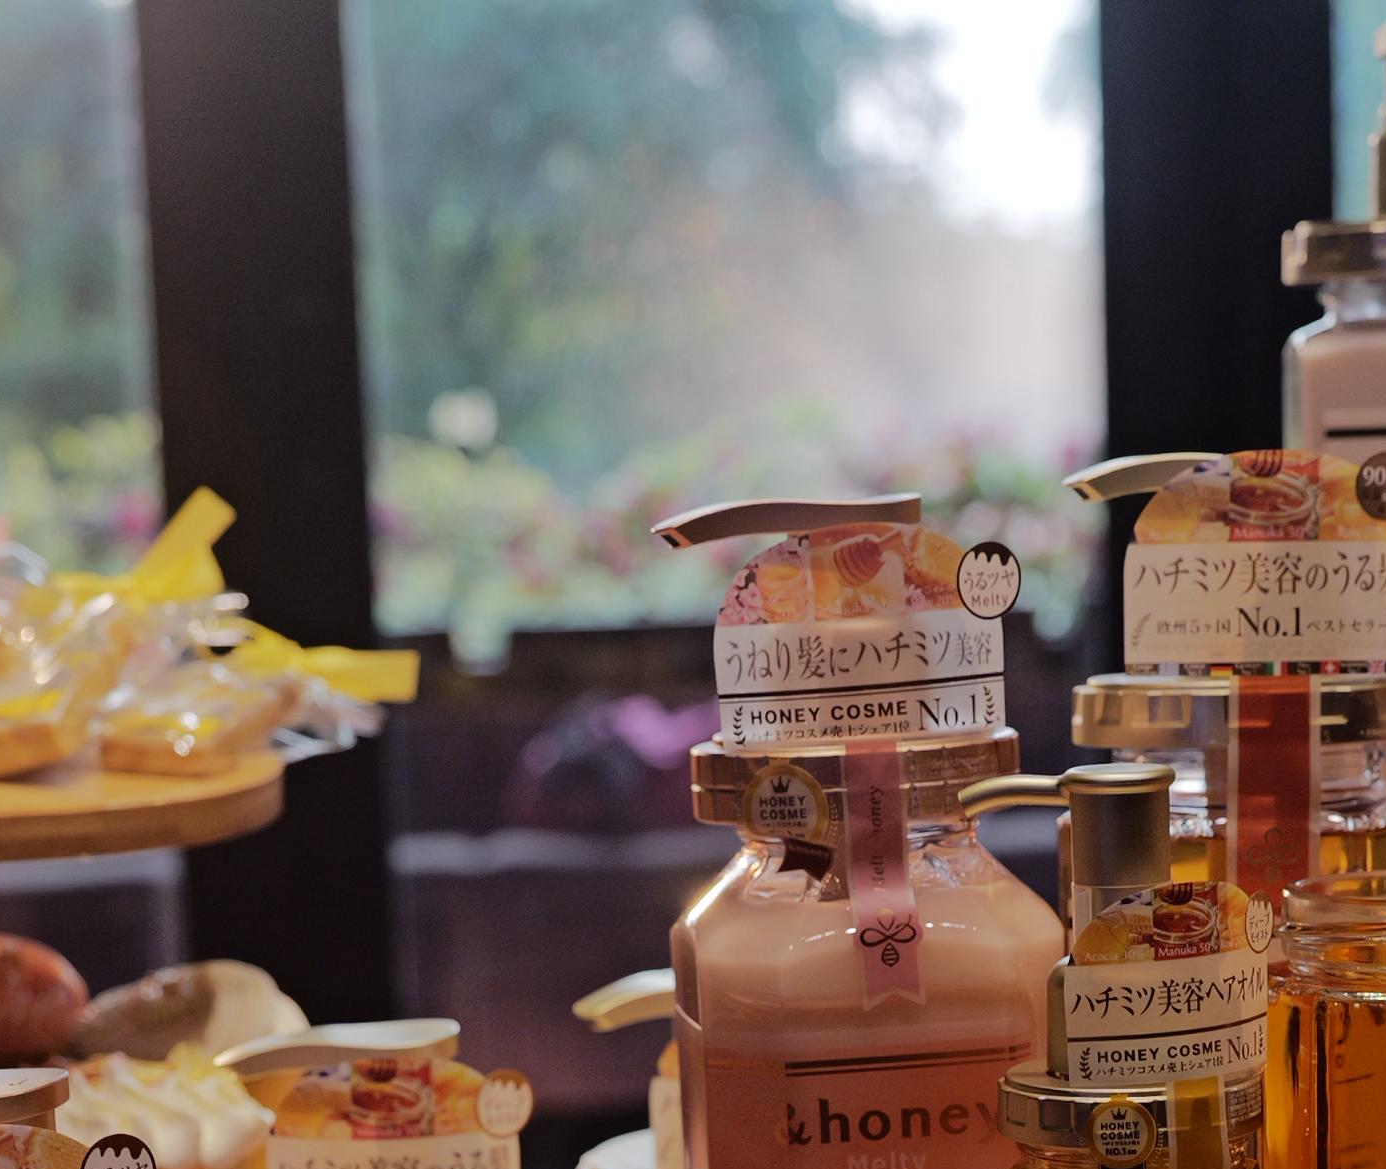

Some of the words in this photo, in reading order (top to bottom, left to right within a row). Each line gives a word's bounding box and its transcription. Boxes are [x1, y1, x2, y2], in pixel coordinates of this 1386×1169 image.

[964, 569, 1014, 592] うるツヤ
[972, 592, 1009, 608] Melty
[1236, 606, 1304, 638] No.1
[725, 630, 992, 686] うねり髪にハチミツ美容
[750, 706, 821, 725] HONEY
[830, 699, 909, 722] COSME
[917, 693, 979, 731] No.1
[759, 795, 806, 808] HONEY
[759, 807, 808, 820] COSME
[1158, 943, 1197, 957] Manuka
[1070, 966, 1264, 1020] ハチミツ美容ヘアオイル
[1097, 1049, 1160, 1063] HONEY
[1167, 1039, 1222, 1059] COSME
[1100, 1120, 1140, 1131] HONEY
[1100, 1130, 1140, 1140] COSME
